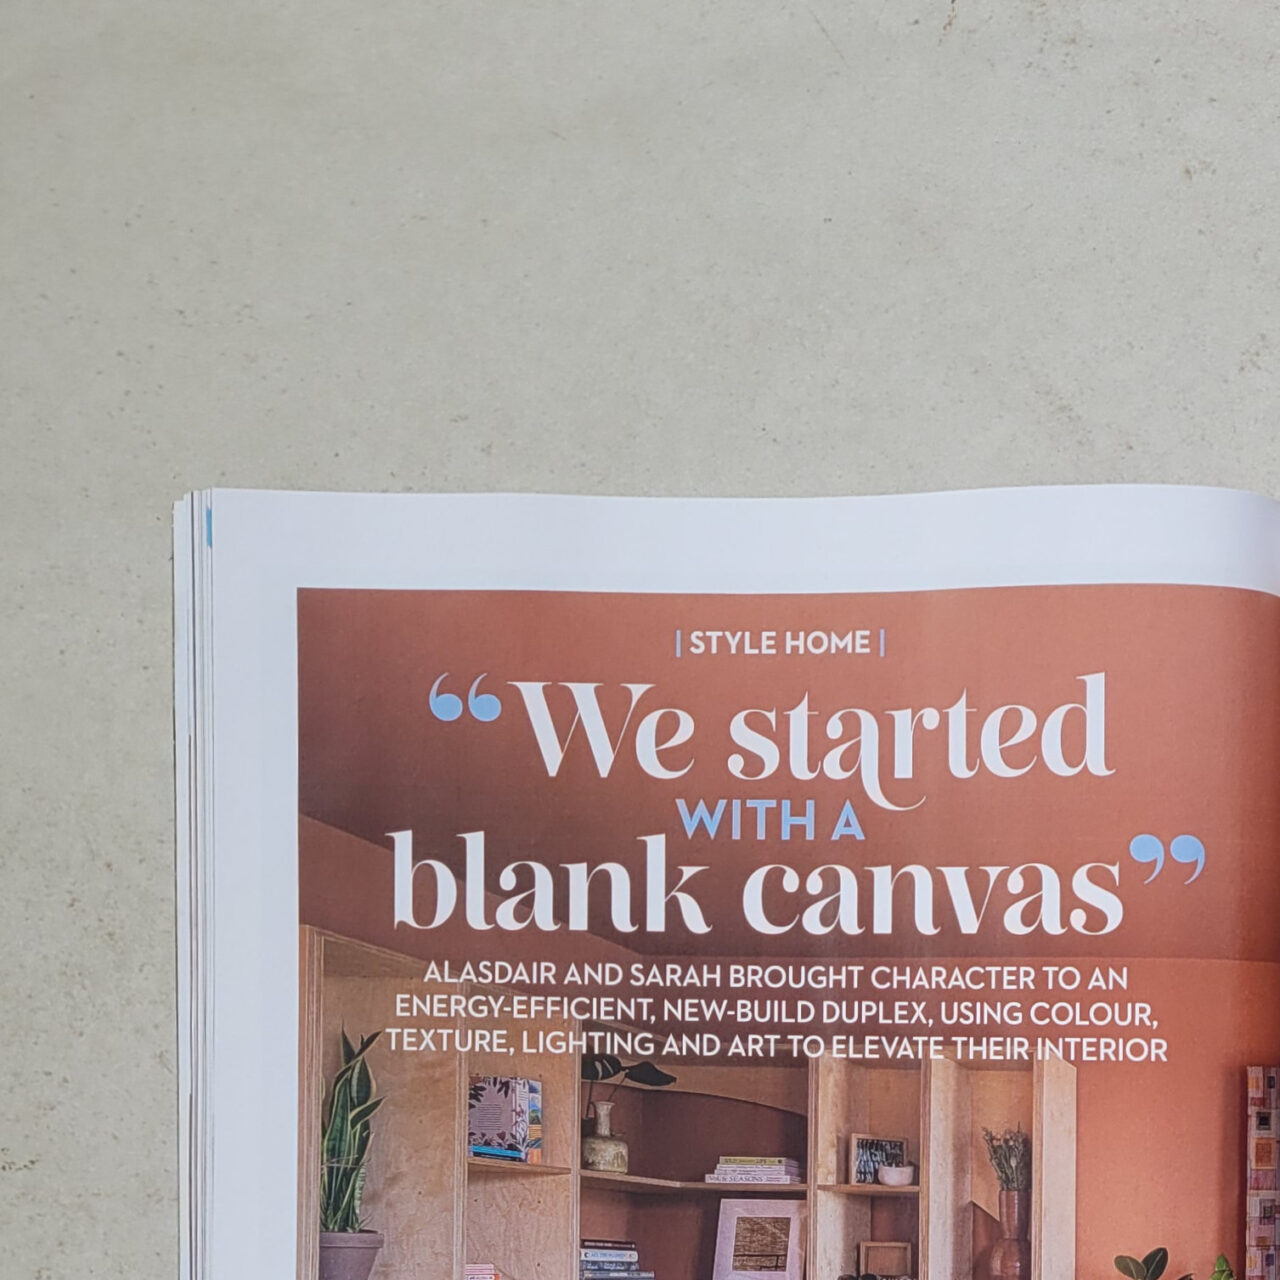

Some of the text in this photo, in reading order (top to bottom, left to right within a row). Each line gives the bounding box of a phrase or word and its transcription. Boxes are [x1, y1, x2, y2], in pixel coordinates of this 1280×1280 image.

[690, 630, 870, 654] STYLE HOME
[728, 672, 1116, 811] started
[675, 798, 866, 840] WITH A
[385, 830, 713, 935] blank
[424, 960, 1127, 990] ALASDAIR AND SARAH BROUGHT CHARACTER TO AN
[396, 994, 1158, 1029] ENERGY-EFFICIENT, NEW-BUILD DUPLEX, USING COLOUR,
[385, 1028, 1167, 1061] TEXTURE, LIGHTING AND ART TO ELEVATE THEIR INTERIOR
